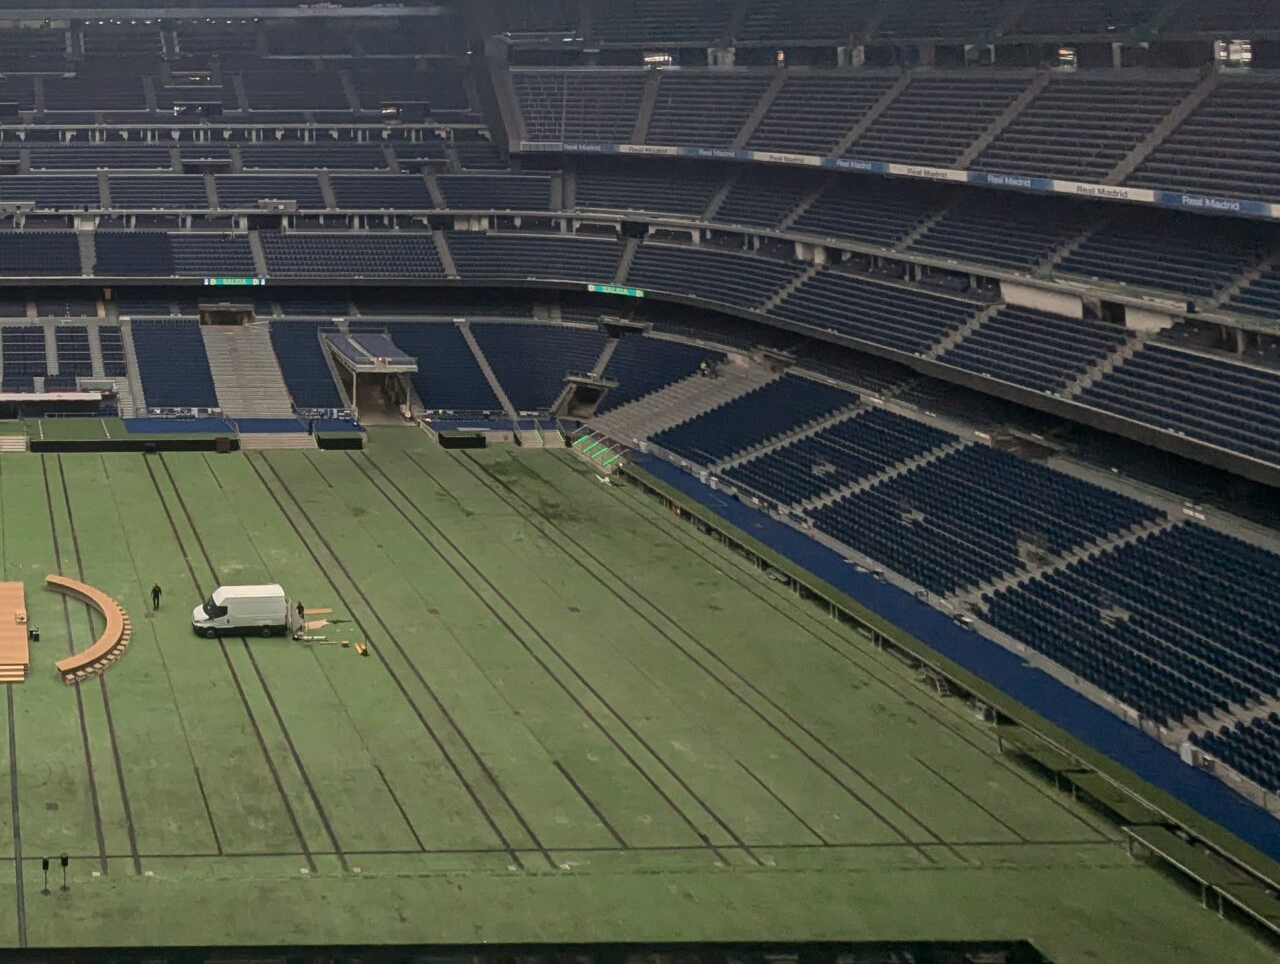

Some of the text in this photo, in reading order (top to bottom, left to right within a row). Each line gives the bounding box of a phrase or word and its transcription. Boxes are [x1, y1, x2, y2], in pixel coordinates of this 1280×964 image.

[1076, 185, 1129, 199] Real Madrid
[1182, 195, 1240, 211] Real Madrid
